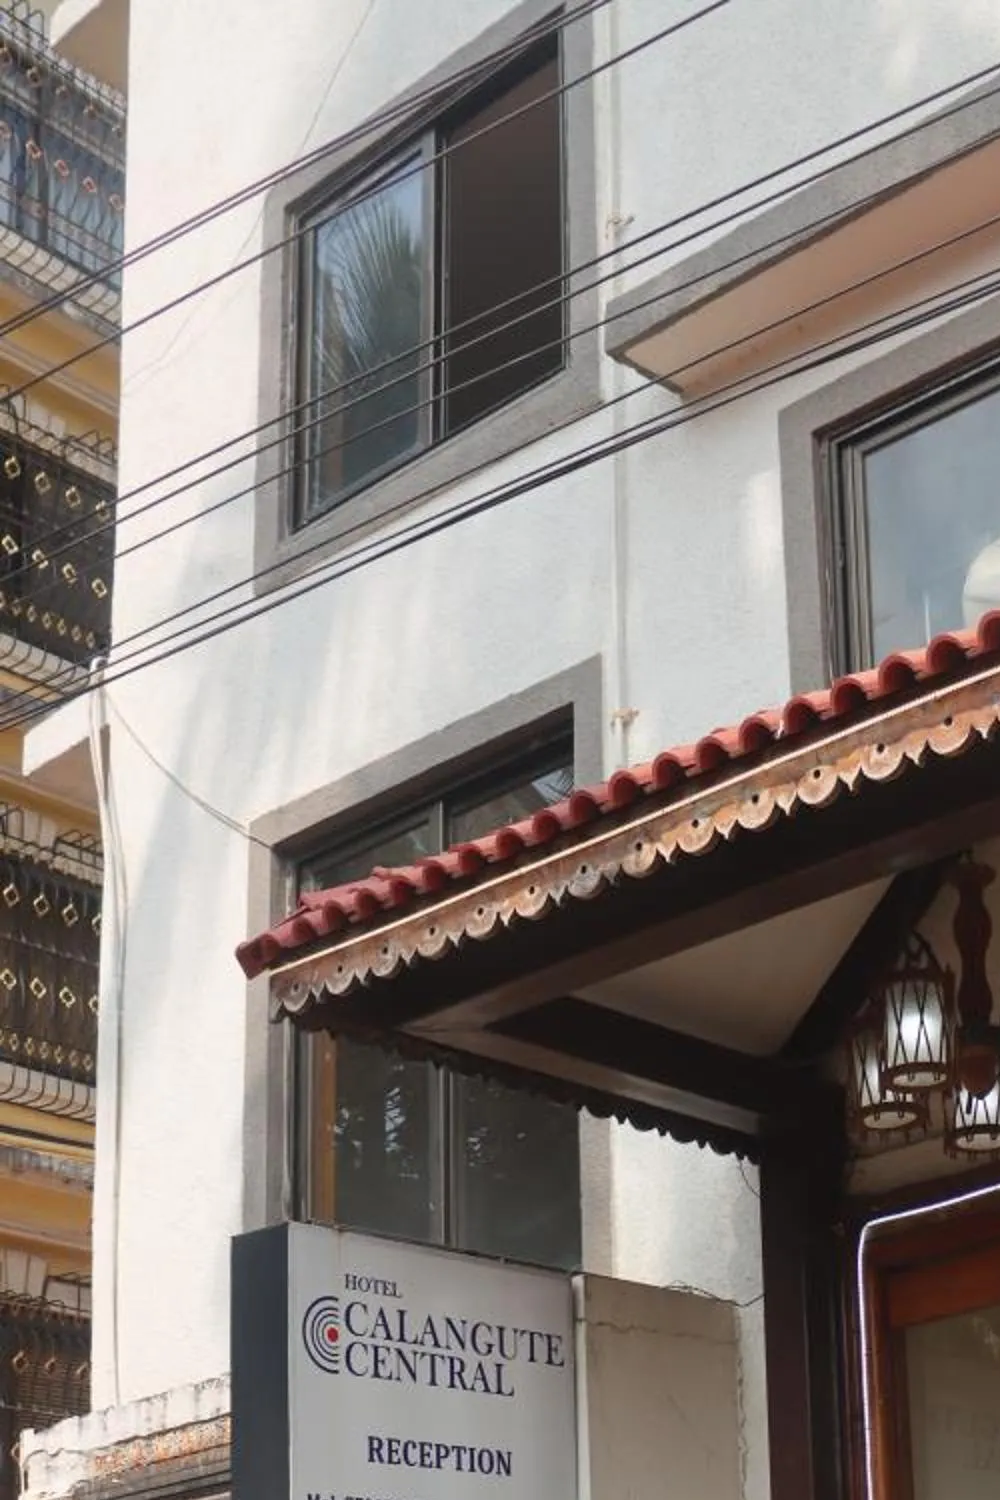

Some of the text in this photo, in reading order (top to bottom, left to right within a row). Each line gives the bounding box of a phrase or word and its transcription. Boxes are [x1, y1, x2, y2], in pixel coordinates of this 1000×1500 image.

[344, 1273, 402, 1298] HOTEL
[344, 1301, 565, 1367] CALANGUTE
[345, 1341, 515, 1397] CENTRAL
[367, 1436, 512, 1476] RECEPTION
